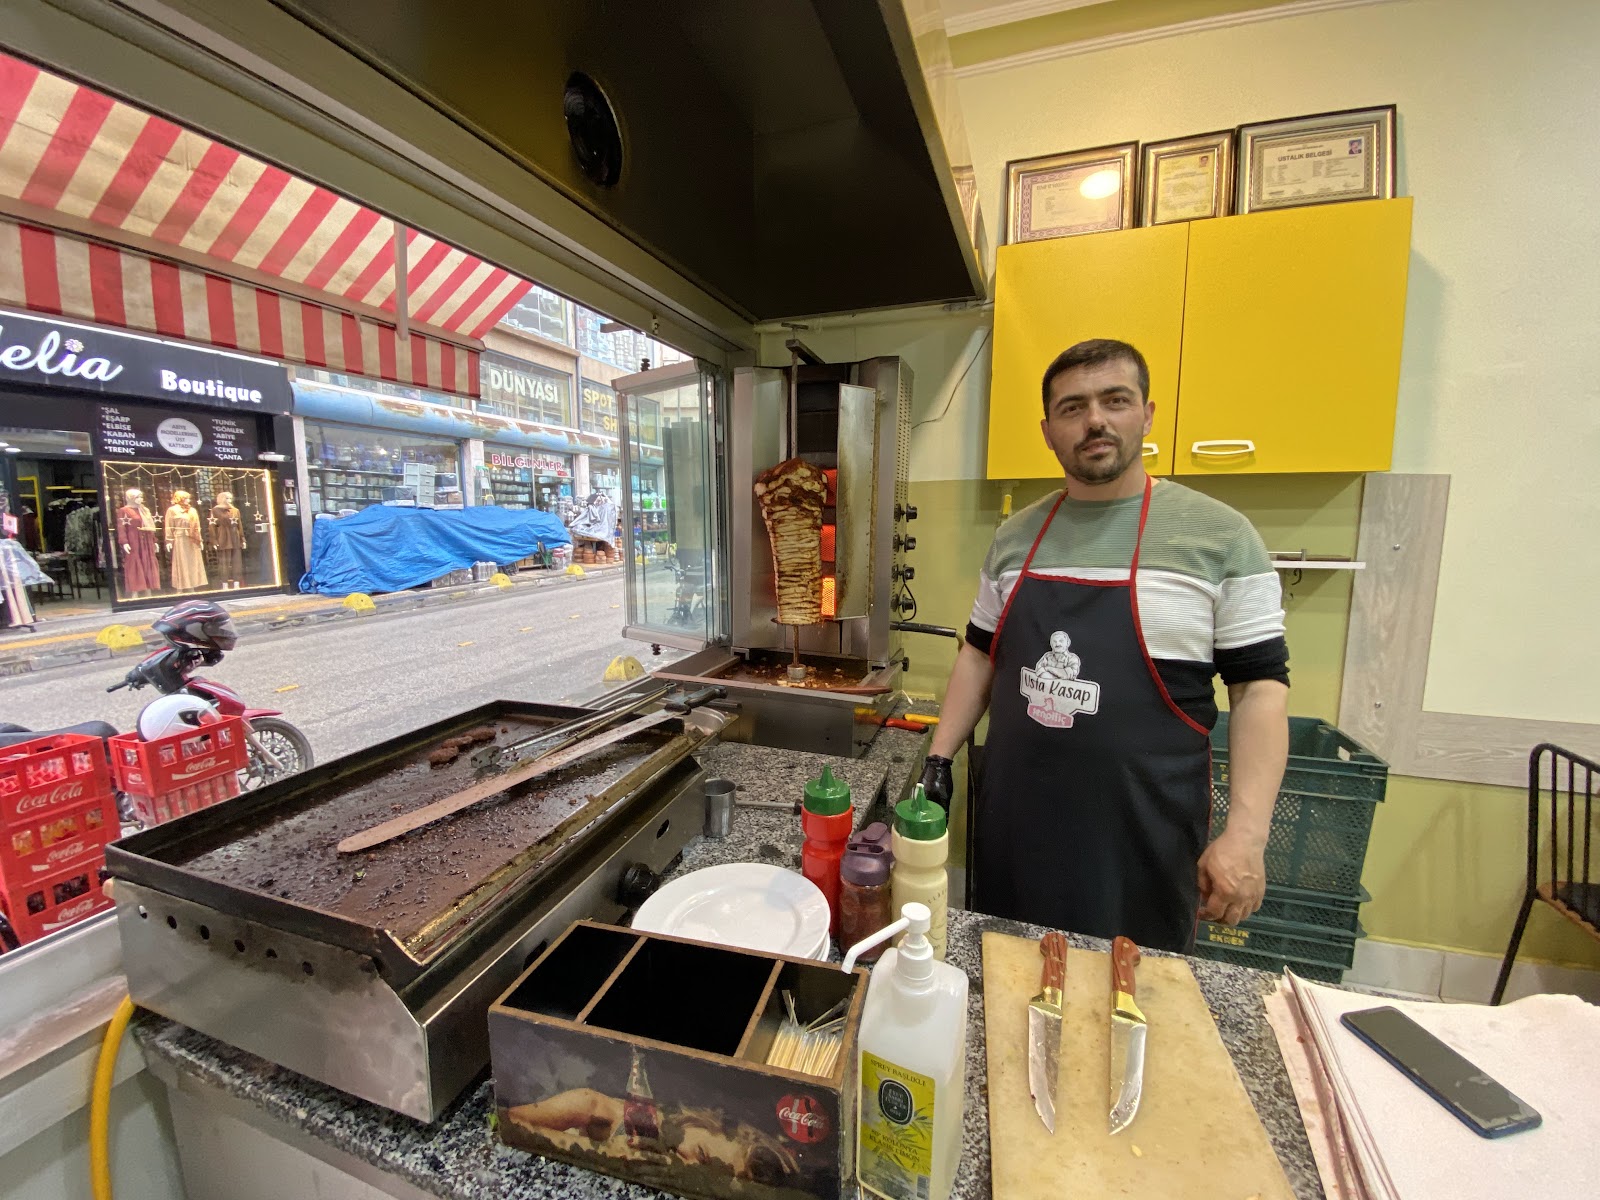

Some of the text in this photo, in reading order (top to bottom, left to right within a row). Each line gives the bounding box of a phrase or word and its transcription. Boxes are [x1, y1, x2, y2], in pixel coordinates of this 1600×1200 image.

[1277, 149, 1332, 162] USTALIK BELGESİ
[0, 325, 123, 381] elia
[160, 369, 262, 403] Boutique
[490, 368, 559, 404] DÜNYASI
[583, 388, 613, 409] SPOT
[106, 430, 136, 439] KABAN
[107, 438, 153, 448] PANTOLON
[108, 446, 136, 456] TRENÇ
[217, 453, 243, 461] ÇANTA
[1024, 674, 1091, 706] Usta Kasap
[870, 1059, 927, 1087] SPREY BAŞLIKLI
[882, 1135, 918, 1155] KOLONYA
